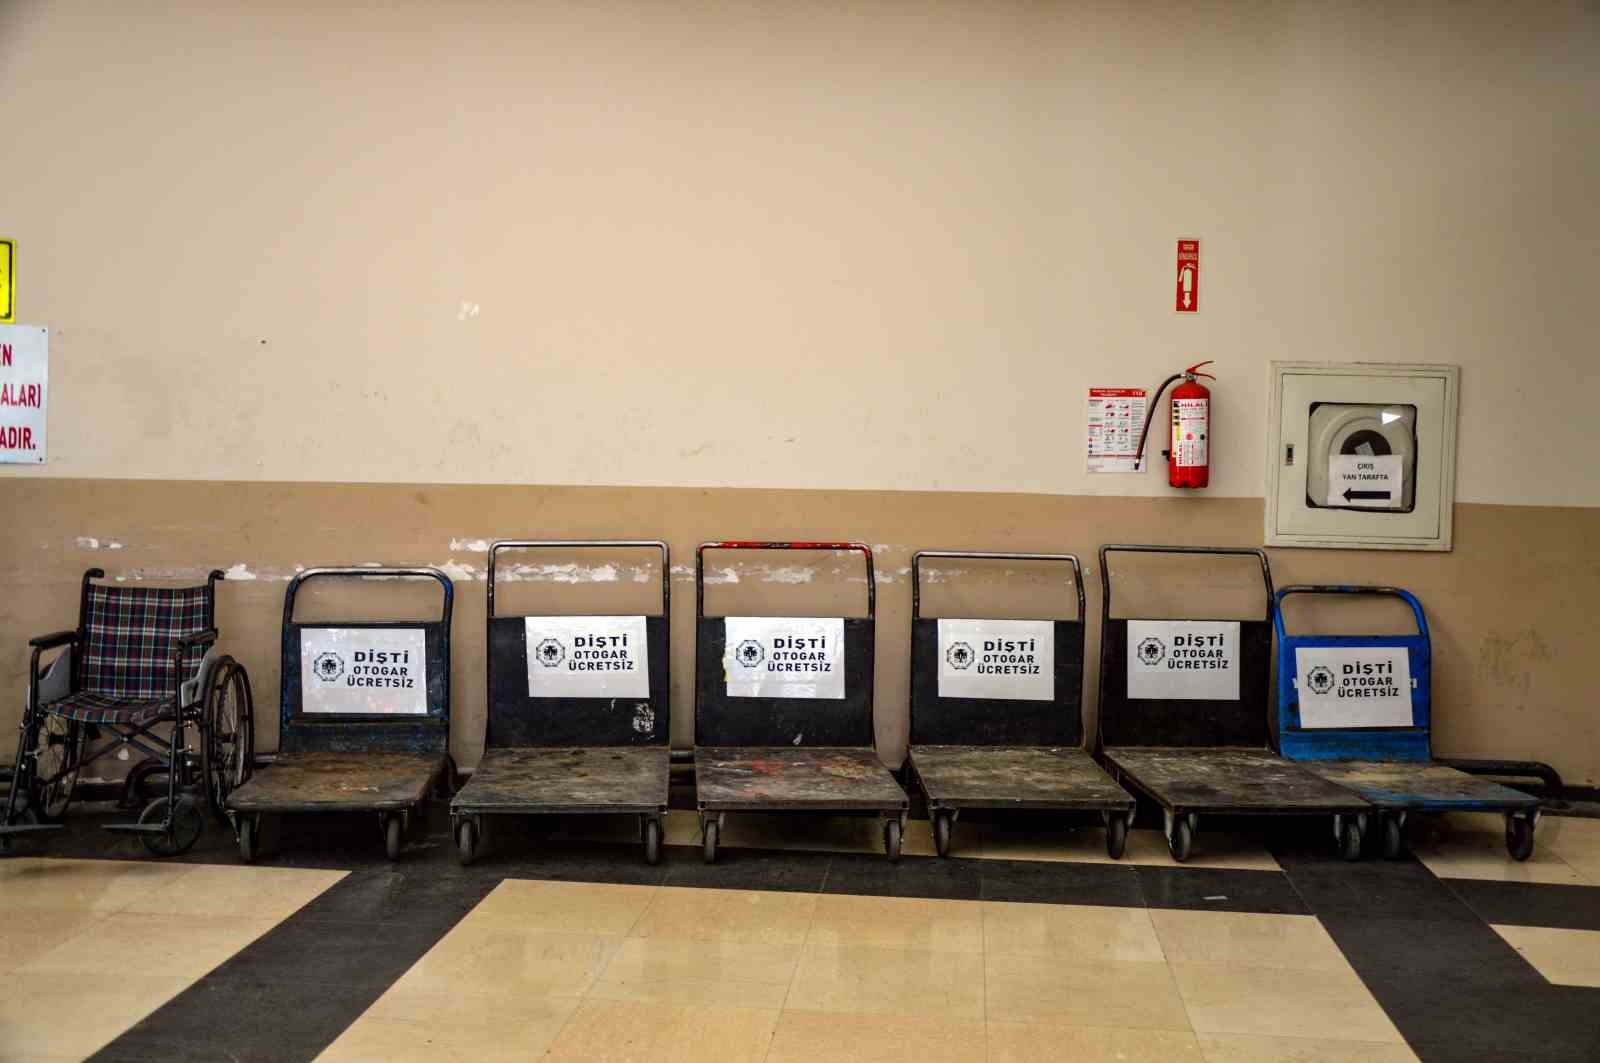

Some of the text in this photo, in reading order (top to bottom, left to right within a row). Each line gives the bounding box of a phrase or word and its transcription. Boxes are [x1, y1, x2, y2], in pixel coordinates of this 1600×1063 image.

[575, 634, 627, 648] DİŞTİ
[774, 636, 826, 649] DİŞTİ
[983, 639, 1035, 652] DİŞTİ
[1174, 633, 1224, 647] DİŞTİ
[354, 648, 409, 664] DİŞTİ
[574, 650, 628, 659] OTOGAR
[773, 652, 825, 660] OTOGAR
[983, 655, 1034, 663] OTOGAR
[1173, 649, 1223, 658] OTOGAR
[568, 659, 634, 671] ÜCRETSİZ
[767, 661, 831, 672] ÜCRETSİZ
[1167, 658, 1229, 669] ÜCRETSİZ
[1342, 661, 1393, 675] DİŞTİ
[354, 666, 408, 675] OTOGAR
[977, 664, 1040, 675] ÜCRETSİZ
[347, 675, 414, 688] ÜCRETSİZ
[1342, 677, 1393, 686] OTOGAR
[1337, 687, 1399, 698] ÜCRETSİZ
